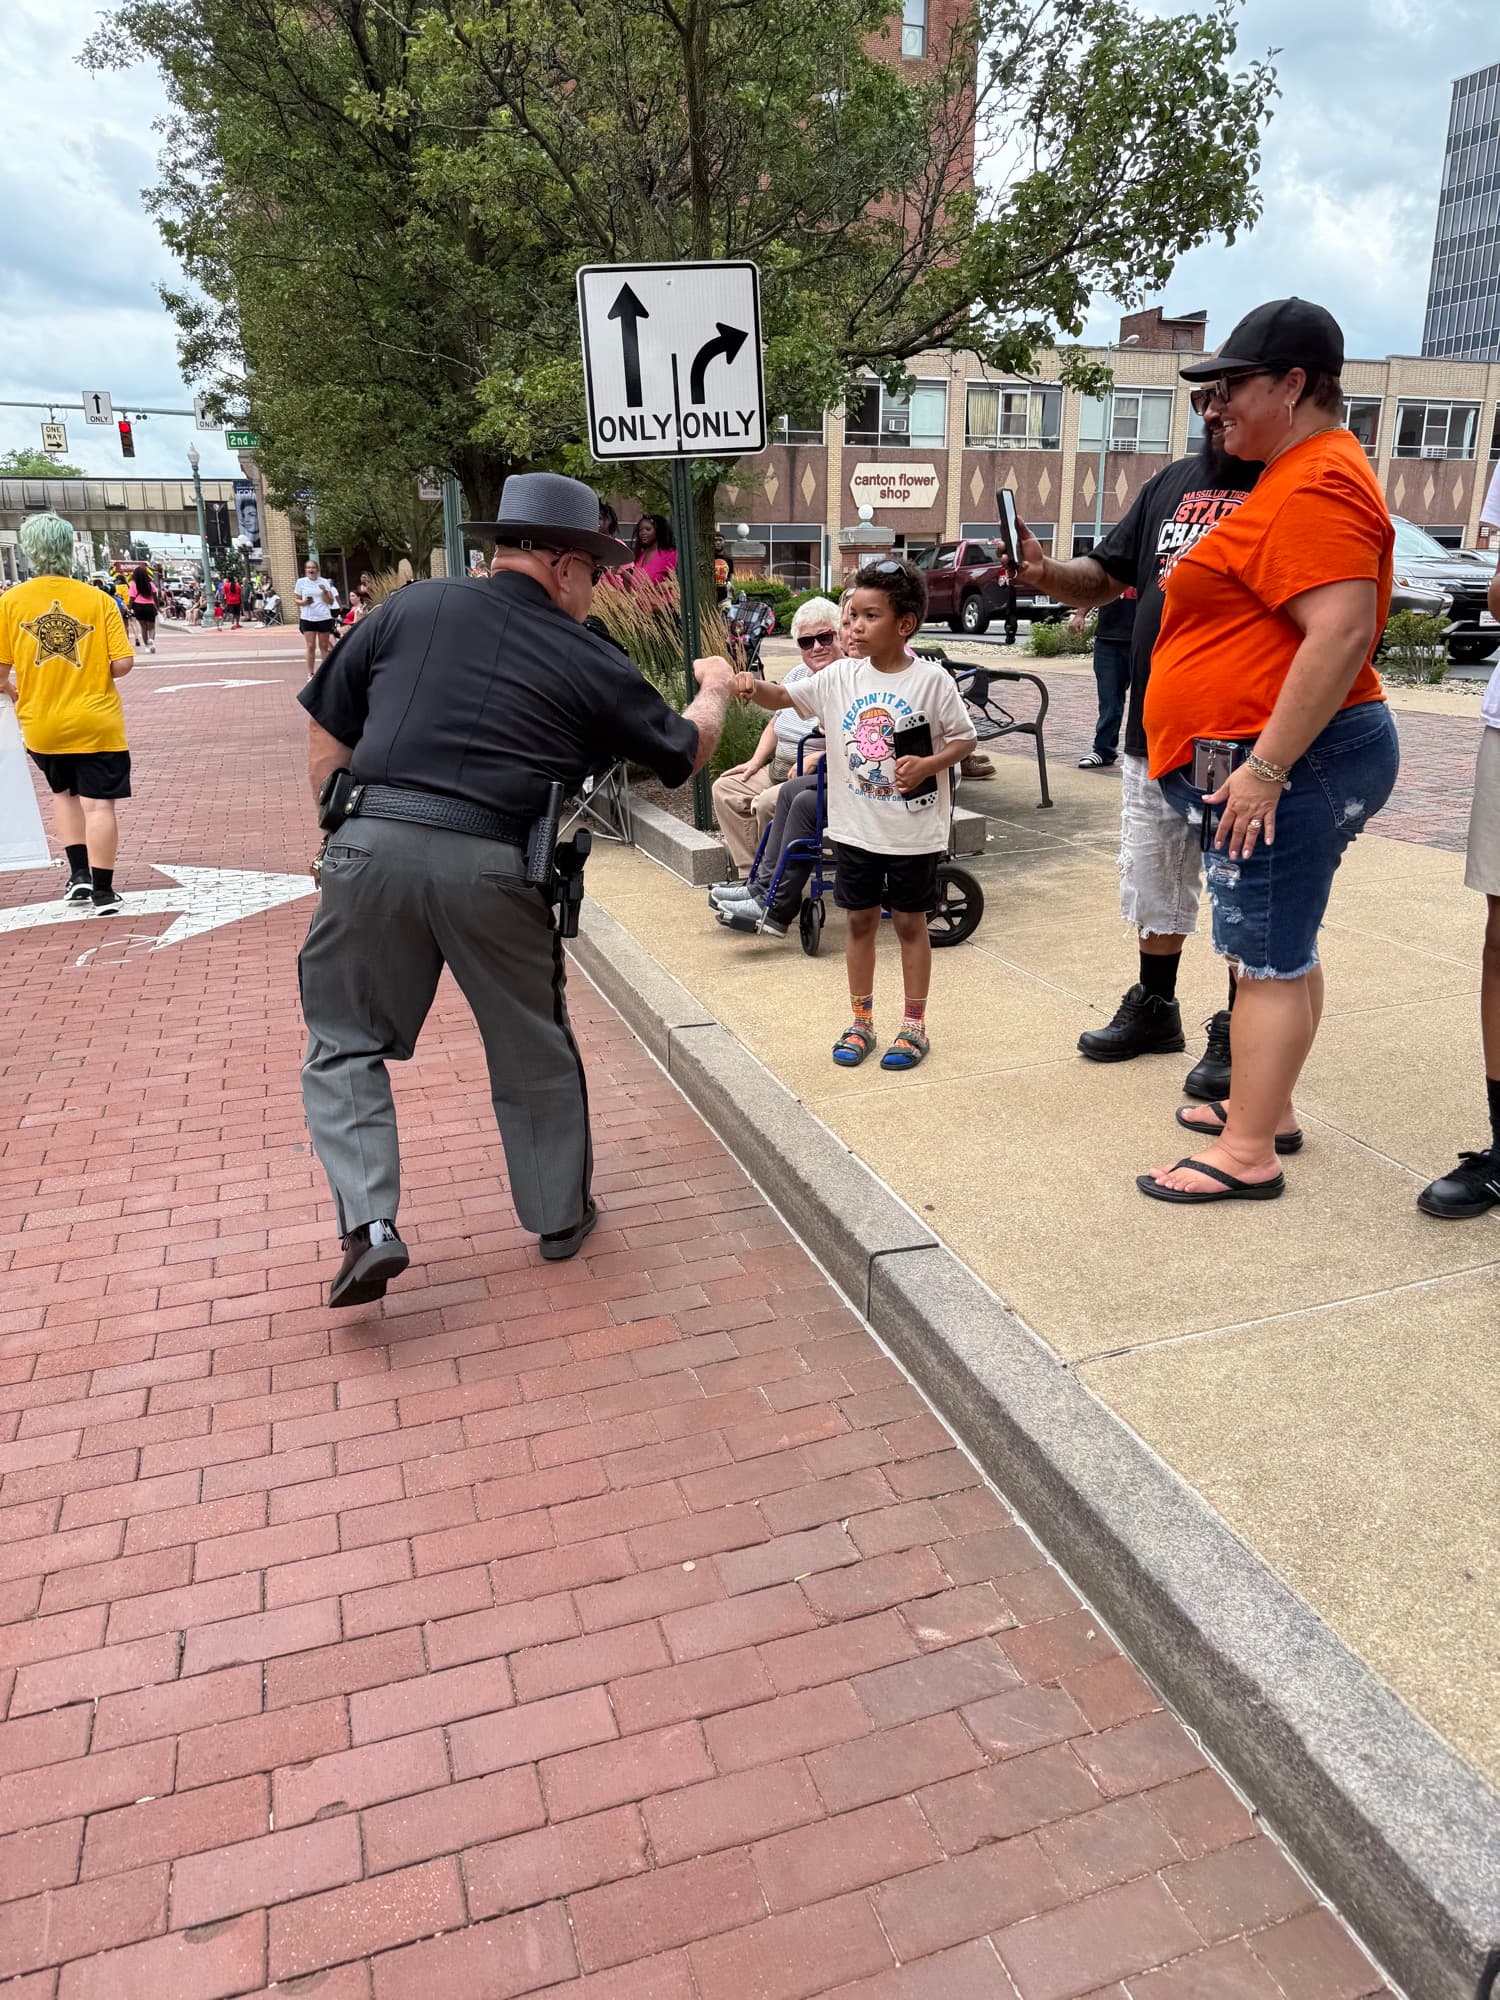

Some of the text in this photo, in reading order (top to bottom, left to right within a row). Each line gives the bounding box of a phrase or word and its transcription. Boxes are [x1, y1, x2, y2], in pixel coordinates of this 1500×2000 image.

[89, 415, 109, 423] ONLY
[682, 410, 756, 439] ONLY
[598, 413, 672, 442] ONLY
[46, 433, 62, 441] WAY
[229, 435, 248, 446] 2nd
[854, 473, 936, 486] canton flower
[879, 487, 910, 502] shop
[1183, 489, 1228, 501] MASSILLON
[1157, 522, 1209, 552] CHA
[882, 692, 896, 704] IT
